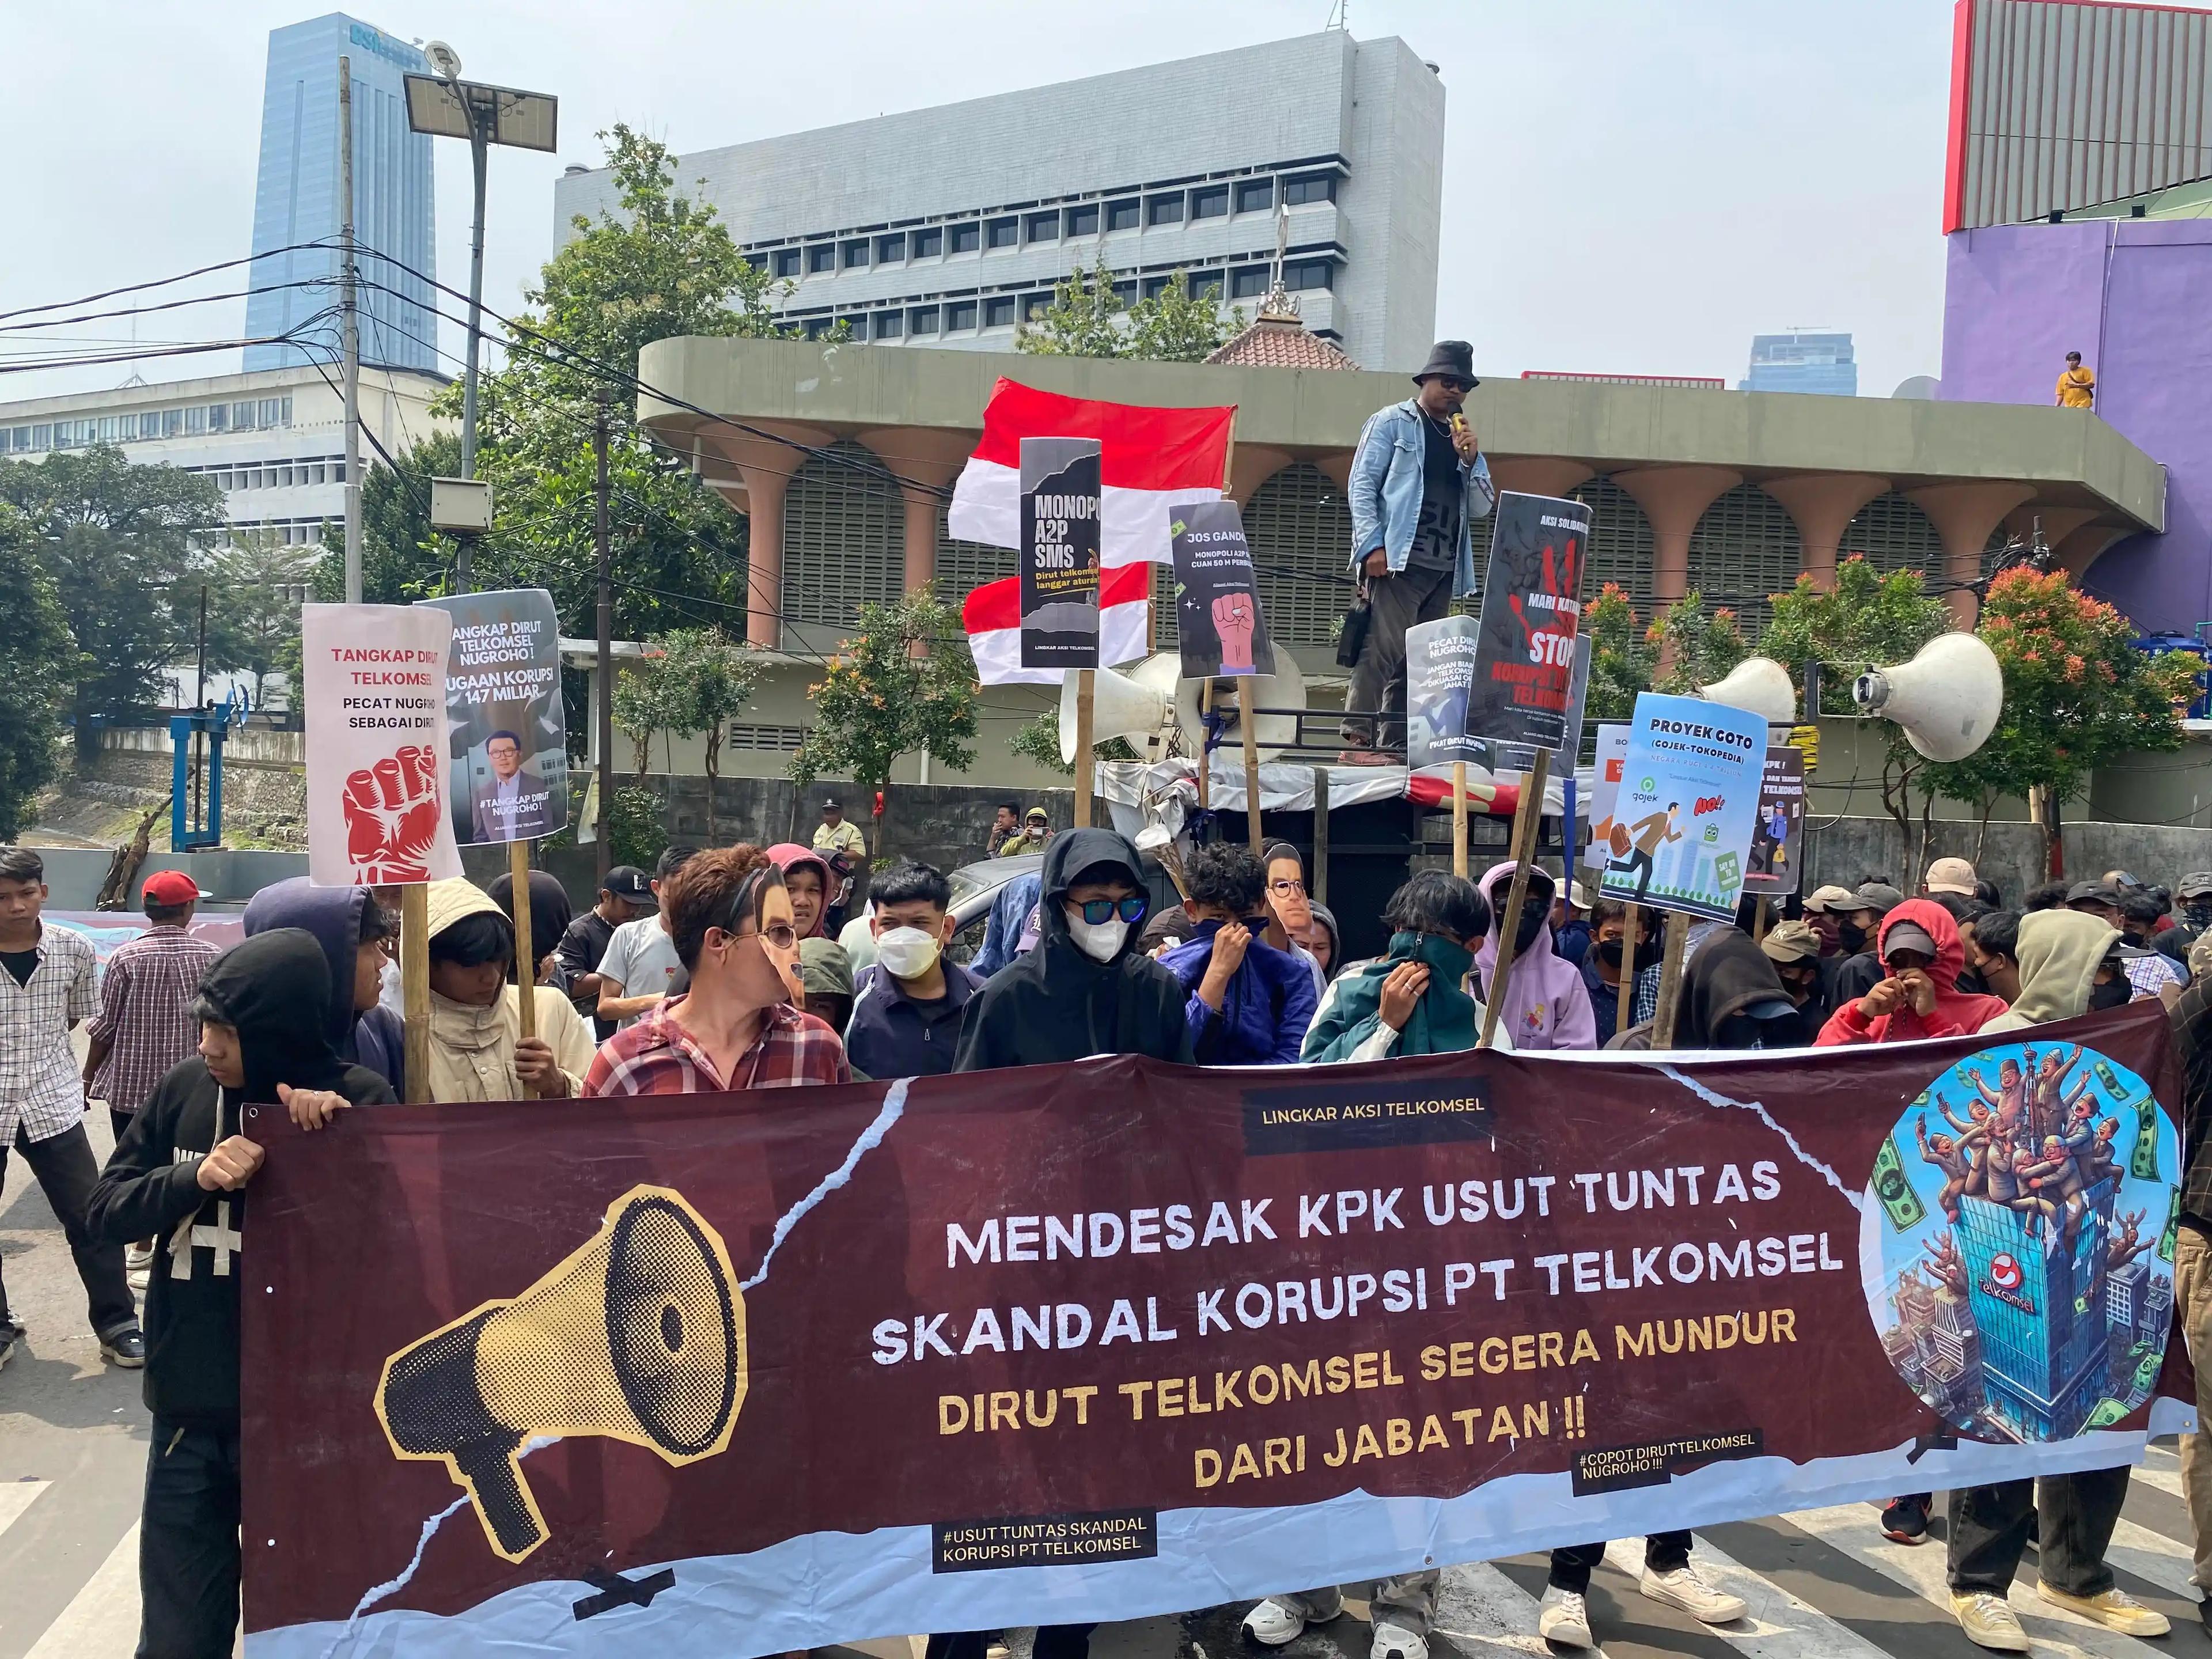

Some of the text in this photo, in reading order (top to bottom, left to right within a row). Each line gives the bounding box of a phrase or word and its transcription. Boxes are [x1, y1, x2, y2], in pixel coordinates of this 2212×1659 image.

[1035, 495, 1101, 521] MONOPO
[1540, 515, 1557, 527] AKSI
[1035, 520, 1068, 543] A2P
[1187, 533, 1211, 543] JOS
[1035, 544, 1074, 568] SMS
[1195, 550, 1233, 558] MONOPOLI
[1191, 560, 1212, 568] CUAN
[1036, 571, 1058, 579] Dirut
[1037, 580, 1070, 589] langgar
[1528, 593, 1556, 610] MARI
[452, 620, 541, 641] ANGKAP DIRUT
[460, 634, 534, 653] TELKOMSEL
[1429, 637, 1458, 650] PECAT
[1529, 631, 1574, 668] STOP
[331, 649, 438, 664] TANGKAP DIRUT
[460, 647, 529, 666] NUGROHO
[1426, 661, 1456, 675] JANGAN
[1438, 668, 1471, 677] TELKOMS
[351, 672, 432, 685] TELKOMSEL
[445, 667, 554, 691] UGAAN KORUPSI
[1428, 674, 1461, 687] DIKUASAI
[1442, 681, 1467, 690] JAHAT
[343, 698, 392, 709] PECAT
[465, 684, 540, 704] 147 MILIAR
[349, 717, 411, 728] SEBAGAI
[1650, 718, 1753, 749] PROYEK GOTO
[1651, 755, 1680, 765] NEGARA
[1652, 739, 1744, 766] (GOJEK-TOKOPEDIA)
[479, 791, 550, 808] #TANGKAP DIRUT
[1633, 793, 1659, 803] gojek
[1262, 1097, 1485, 1124] LINGKAR AKSI TELKOMSEL
[946, 1160, 1782, 1268] MENDESAK KPK USUT TUNTAS
[872, 1232, 1843, 1366] SKANDAL KORUPSI PT TELKOMSEL
[938, 1307, 1798, 1435] DIRUT TELKOMSEL SEGERA MUNDUR
[1194, 1394, 1586, 1488] DARI JABATAN !!
[1578, 1433, 1755, 1468] #COPOT DIRUT TELKOMSEL
[1582, 1459, 1650, 1480] NUGROHO
[943, 1517, 1147, 1544] #USUT TUNTAS SKANDAL
[943, 1535, 1142, 1563] KORUPSI PT TELKOMSEL
